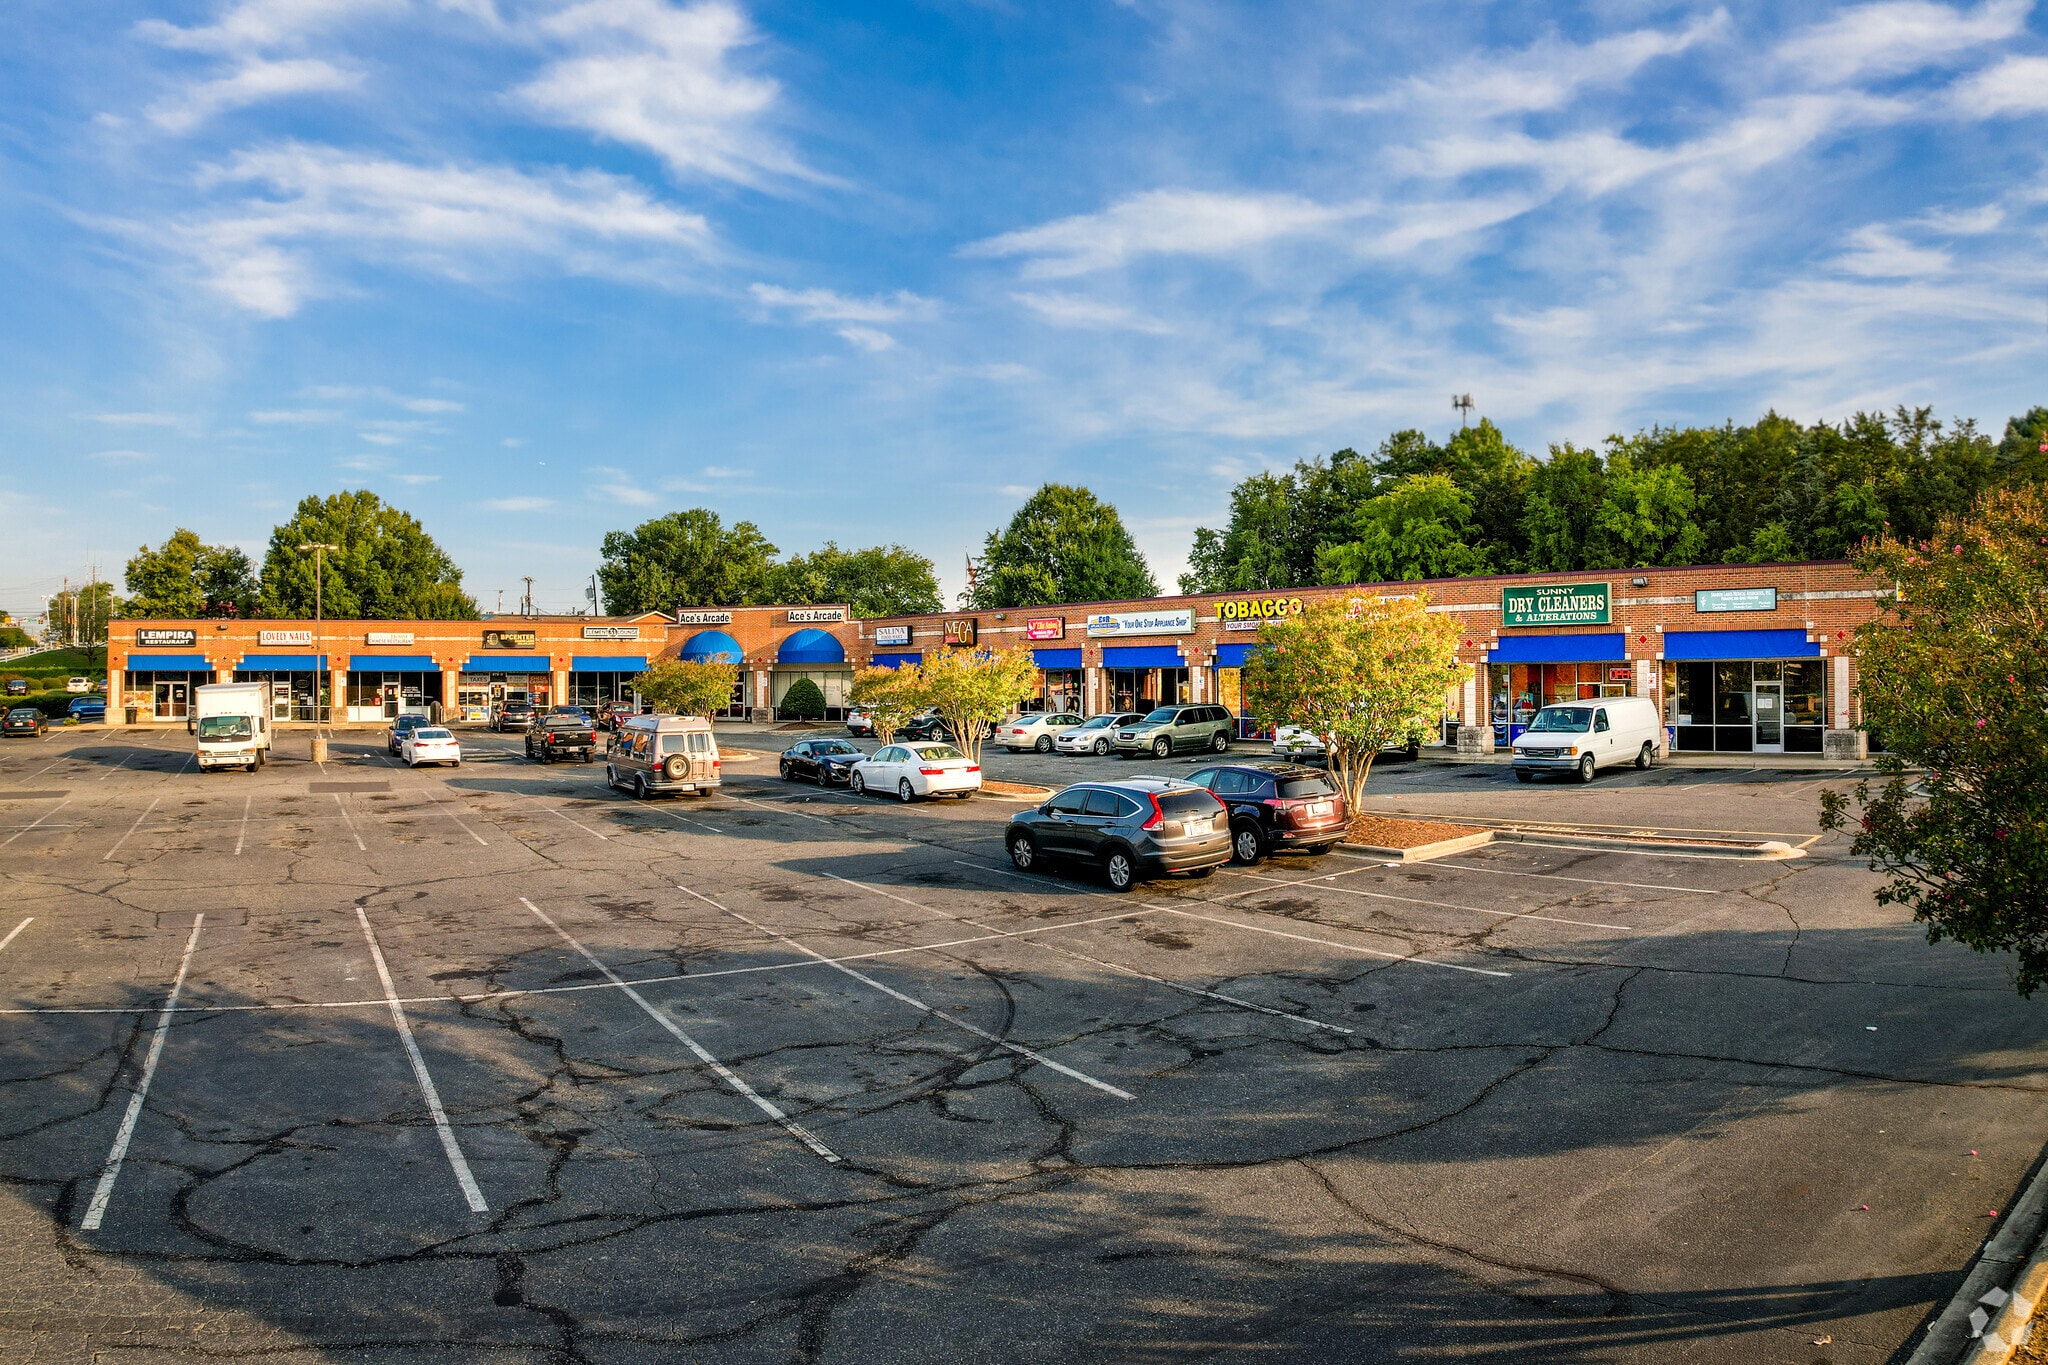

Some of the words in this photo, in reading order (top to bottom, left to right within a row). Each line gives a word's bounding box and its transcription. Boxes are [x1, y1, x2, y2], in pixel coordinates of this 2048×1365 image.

[1536, 587, 1575, 596] SUNNY
[1213, 597, 1302, 619] TOBACCO
[1508, 597, 1534, 614] DRY
[1537, 594, 1605, 613] CLEANERS
[680, 613, 701, 623] Ace's
[702, 613, 730, 623] Arcade
[789, 611, 811, 621] Ace's
[814, 610, 842, 620] Arcade
[1515, 614, 1523, 622] &
[1526, 612, 1597, 622] ALTERATIONS
[1226, 621, 1242, 629] YOUR
[141, 630, 194, 640] LEMPIRA
[878, 627, 905, 635] SALINA
[945, 621, 973, 643] MEGA
[262, 632, 287, 641] LOVELY
[289, 632, 311, 641] NAILS
